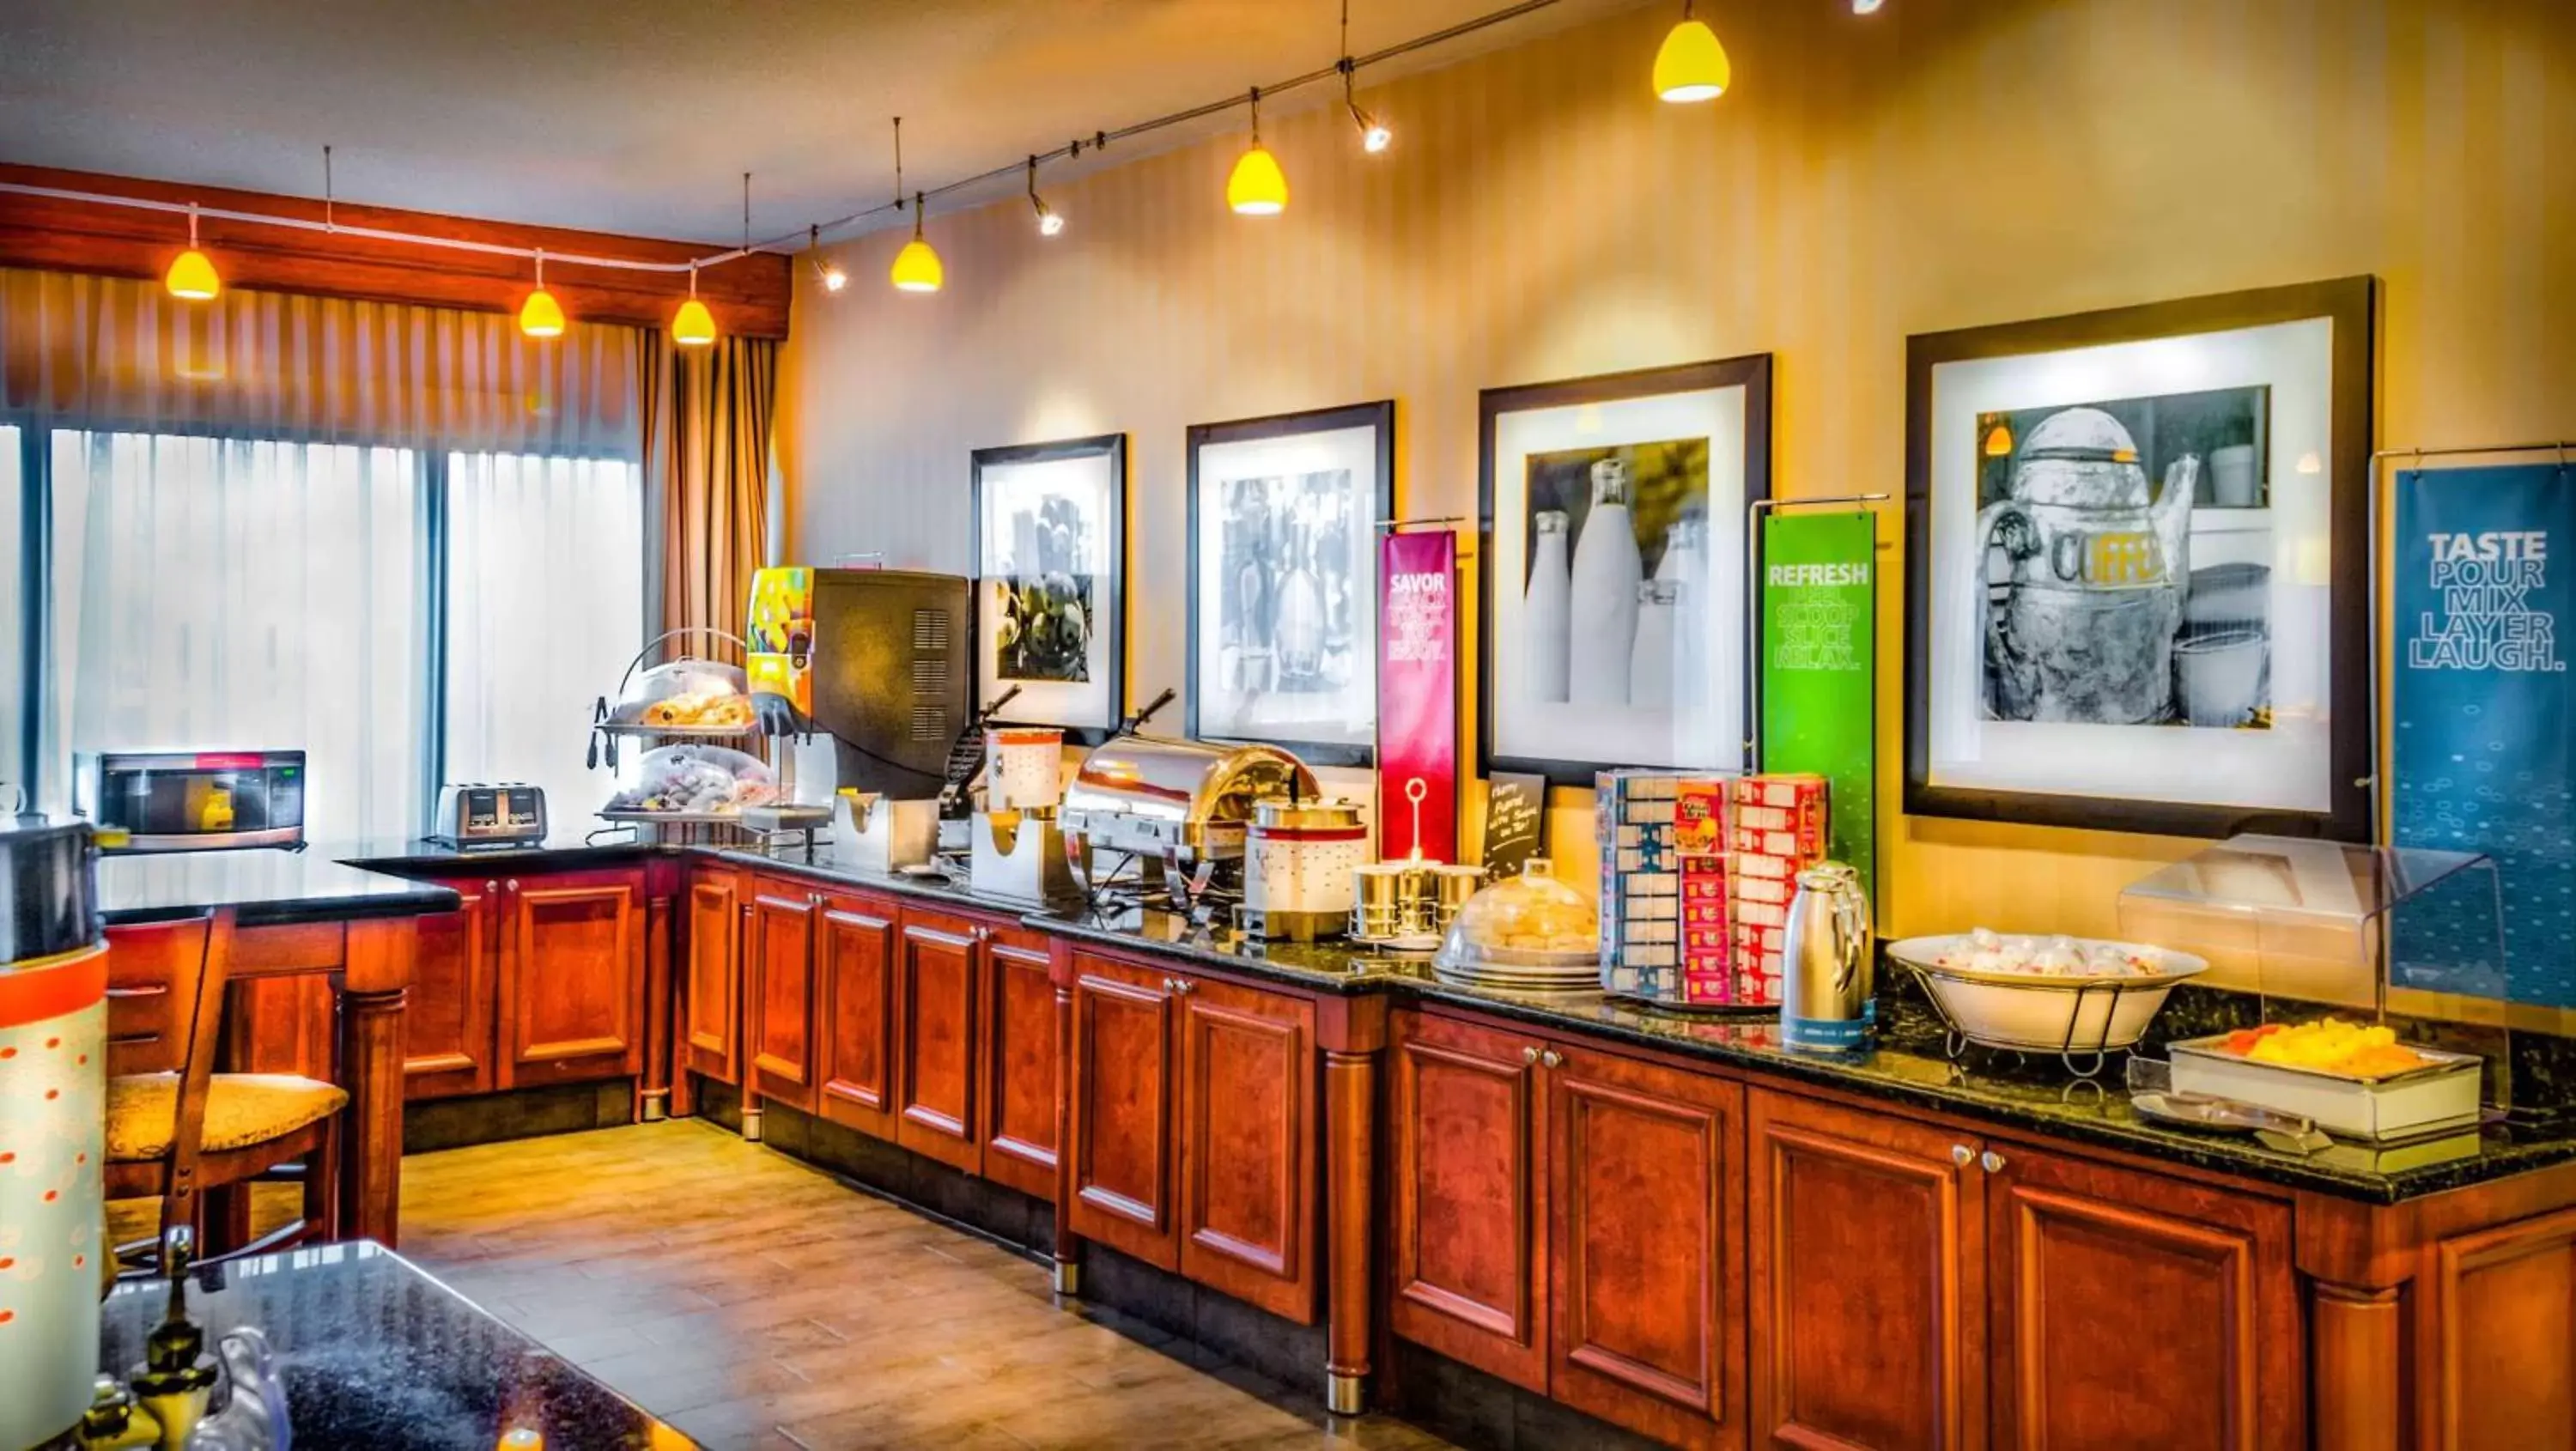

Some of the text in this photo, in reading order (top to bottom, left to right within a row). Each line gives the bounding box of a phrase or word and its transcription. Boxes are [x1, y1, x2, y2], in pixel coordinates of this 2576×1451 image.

[2427, 531, 2548, 560] TASTE
[1389, 573, 1445, 592] SAVOR
[1769, 562, 1868, 586] REFRESH
[2430, 559, 2545, 588] POUR
[2445, 586, 2530, 615] MIX
[1776, 603, 1860, 628] SCOOP
[2421, 612, 2555, 641] LAYER
[2409, 638, 2567, 671] LAUGH.
